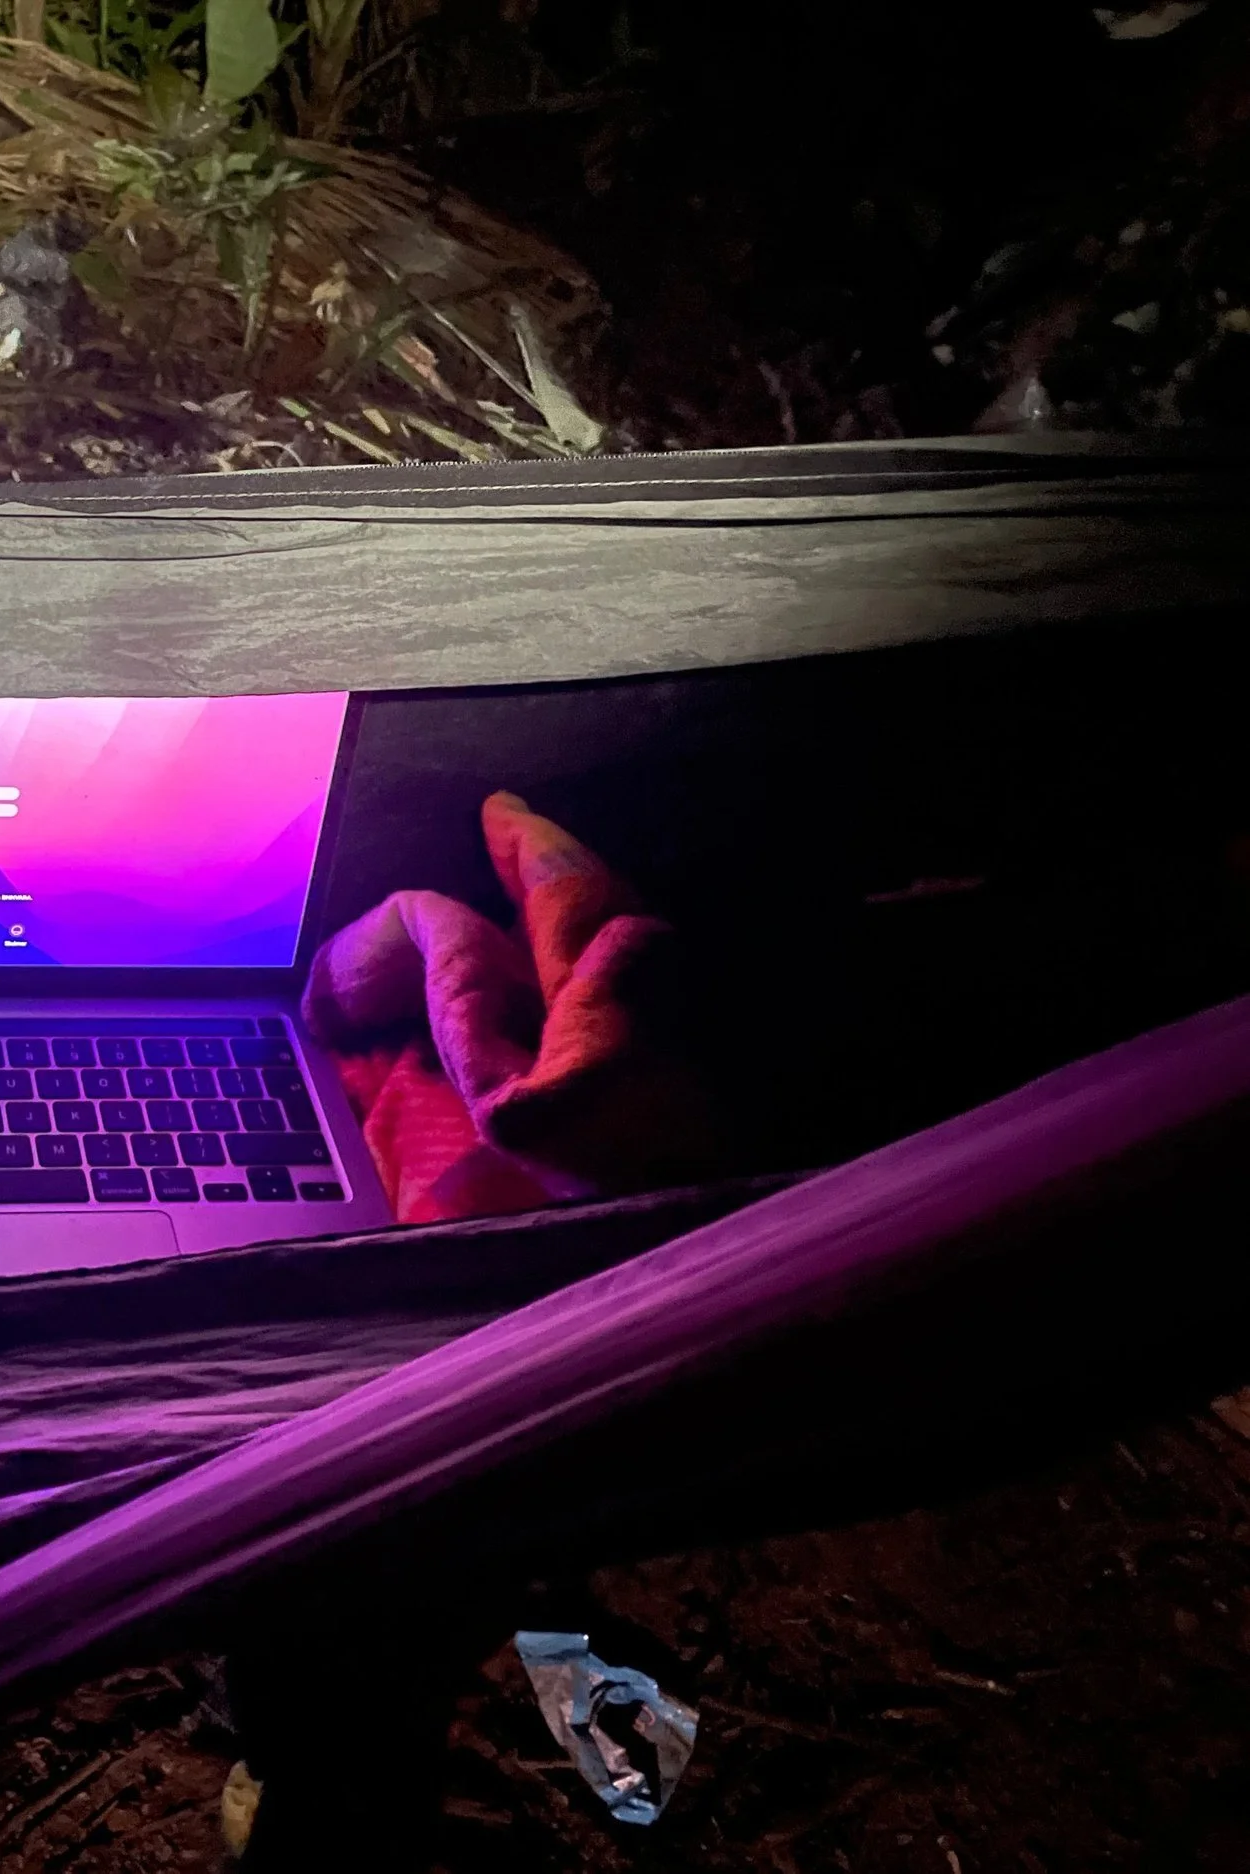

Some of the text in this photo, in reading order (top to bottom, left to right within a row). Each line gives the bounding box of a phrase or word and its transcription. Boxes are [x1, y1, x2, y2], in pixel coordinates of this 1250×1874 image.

[6, 1079, 16, 1088] U
[144, 1077, 154, 1087] P
[25, 1111, 33, 1121] J
[70, 1111, 80, 1120] K
[118, 1110, 127, 1120] L
[5, 1145, 16, 1155] N
[52, 1144, 65, 1154] M
